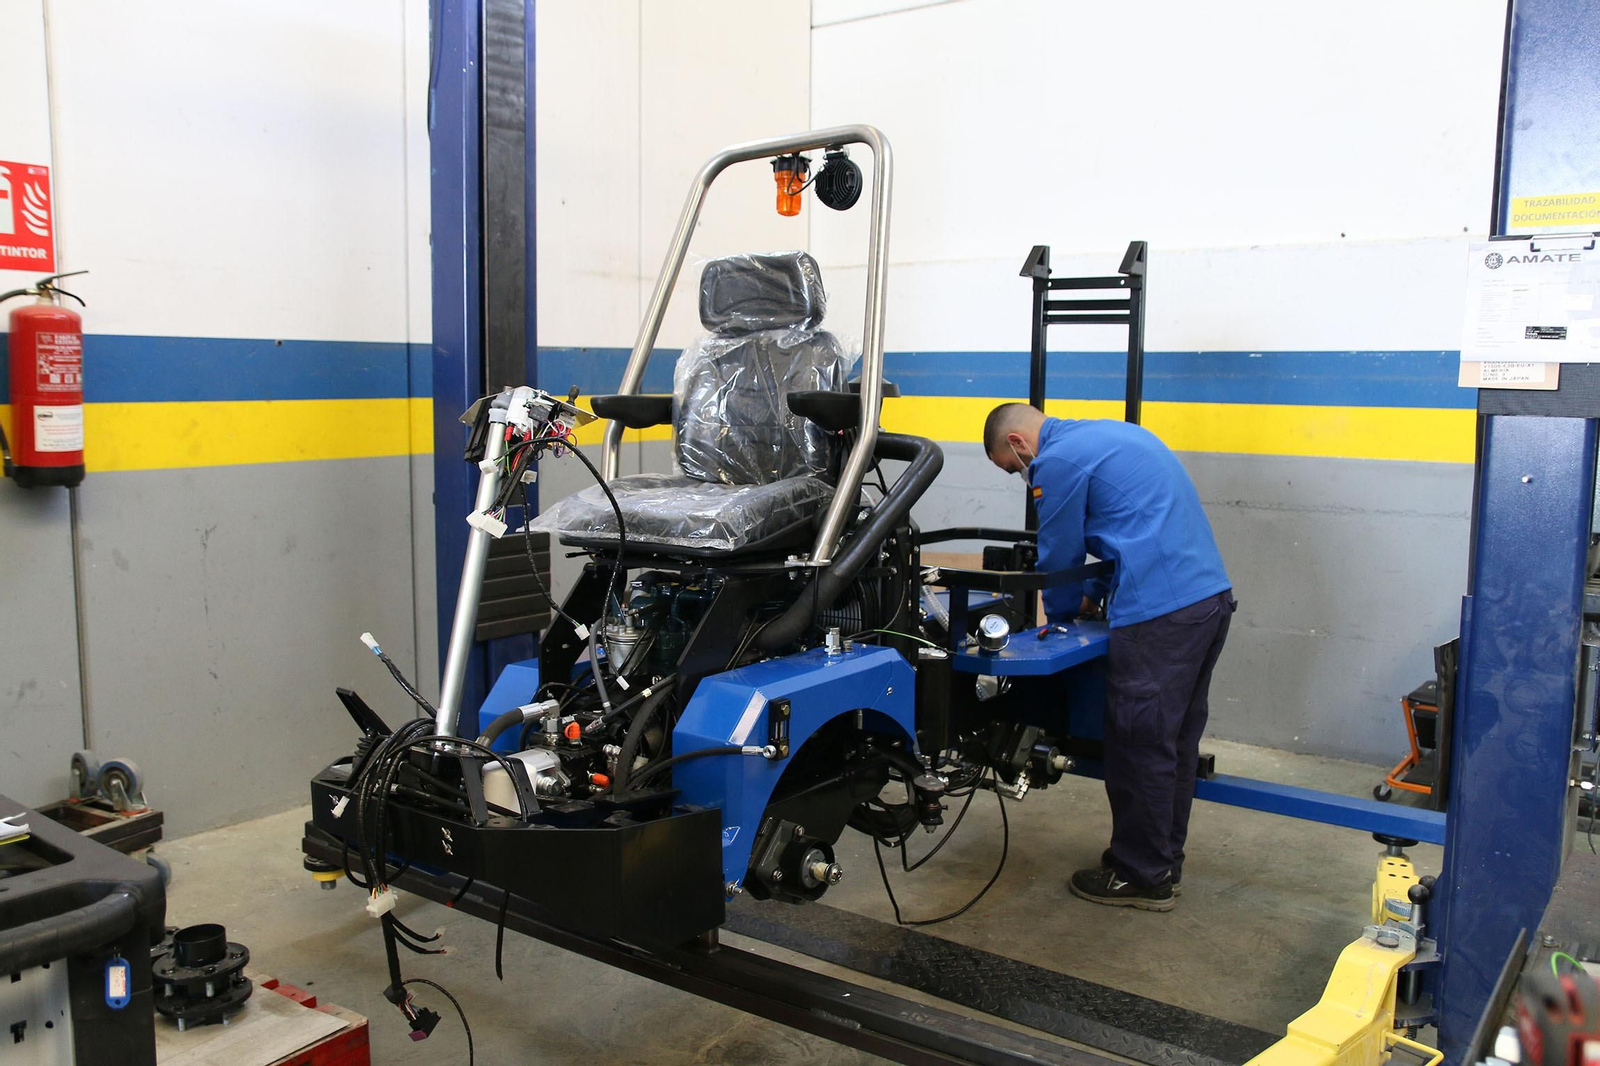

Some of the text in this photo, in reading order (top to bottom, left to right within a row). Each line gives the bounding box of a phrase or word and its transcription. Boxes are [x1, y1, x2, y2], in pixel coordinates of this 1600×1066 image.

[1524, 196, 1596, 208] TRAZABILIDAD
[0, 244, 47, 259] TINTOR
[1506, 253, 1581, 264] AMATE
